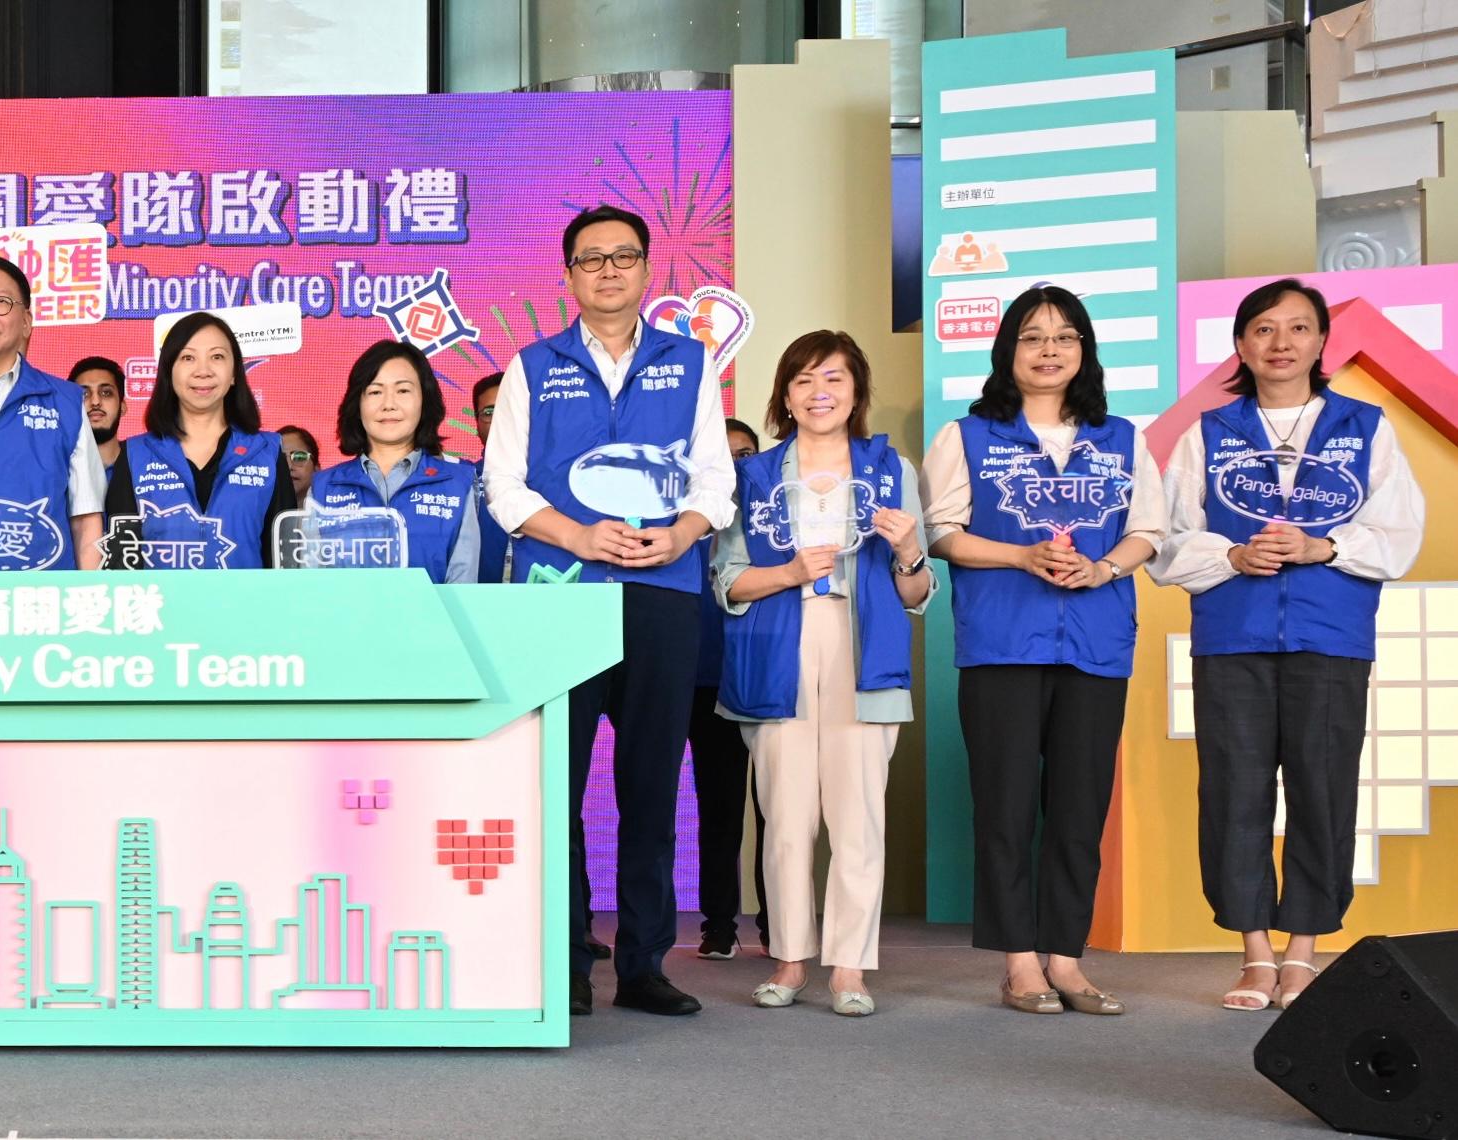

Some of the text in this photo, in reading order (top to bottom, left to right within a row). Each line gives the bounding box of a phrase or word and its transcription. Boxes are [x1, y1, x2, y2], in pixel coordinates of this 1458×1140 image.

[945, 188, 995, 202] 主辦單位
[106, 263, 239, 311] Minority
[251, 261, 325, 309] Care
[944, 303, 994, 316] RTHK
[266, 327, 293, 335] (YTM)
[942, 321, 996, 335] 香港電台
[549, 365, 580, 377] Ethnic
[543, 377, 585, 389] Minority
[539, 389, 590, 402] Care Team
[988, 446, 1025, 455] Ethnic
[228, 474, 266, 487] 關愛隊
[980, 470, 1005, 480] Care
[135, 482, 185, 495] Care Team
[325, 492, 357, 503] Ethnic
[410, 491, 460, 508] 少數族裔
[415, 505, 454, 520] 關愛隊
[119, 530, 208, 569] हेरचाह
[289, 529, 394, 565] देखभाल
[32, 643, 154, 690] Care
[166, 642, 306, 689] Team
